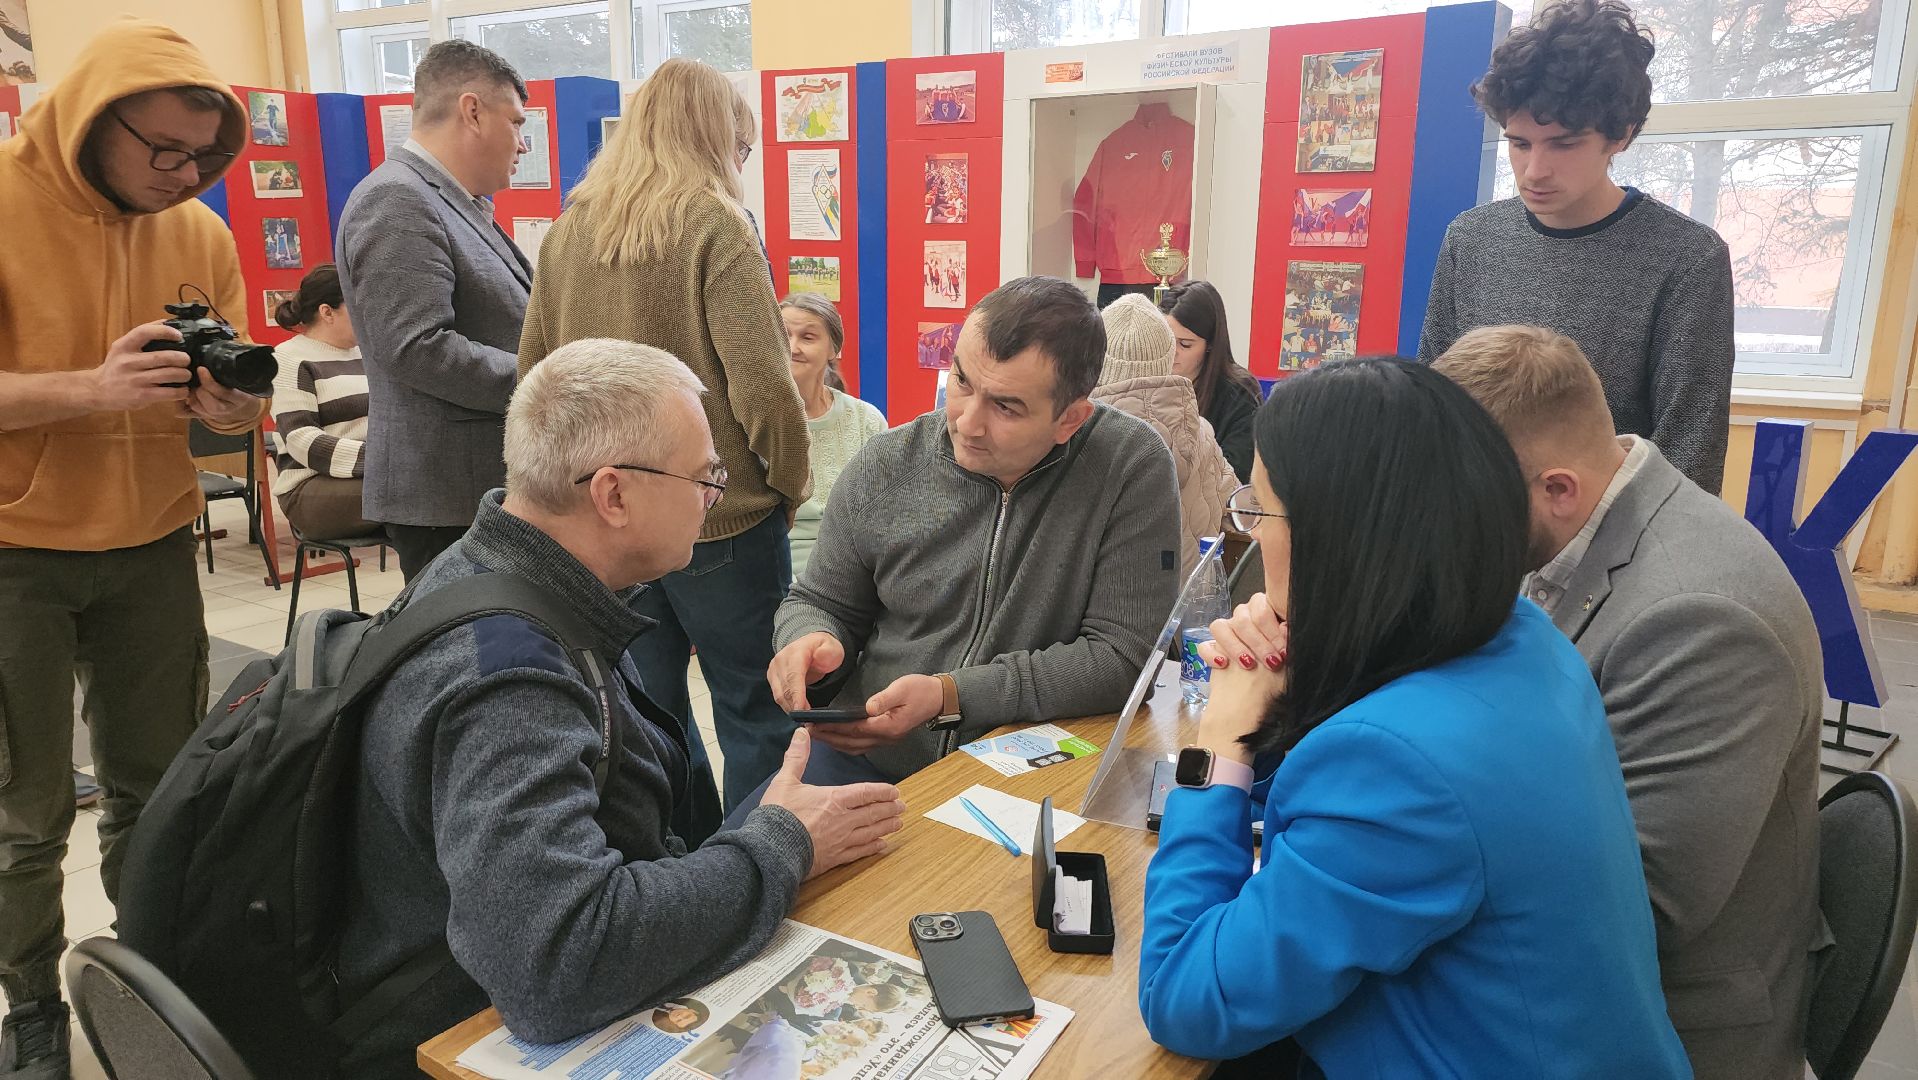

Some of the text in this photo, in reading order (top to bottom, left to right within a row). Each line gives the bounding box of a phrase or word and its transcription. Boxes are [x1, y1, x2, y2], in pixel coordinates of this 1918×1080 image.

[1156, 47, 1223, 60] ФЕСТИВАЛИ ВУЗОВ
[1146, 56, 1232, 70] ФИЗИЧЕСКОЙ КУЛЬТУРЫ
[1143, 65, 1235, 79] РОССИЙСКОЙ ФЕДЕРАЦИИ
